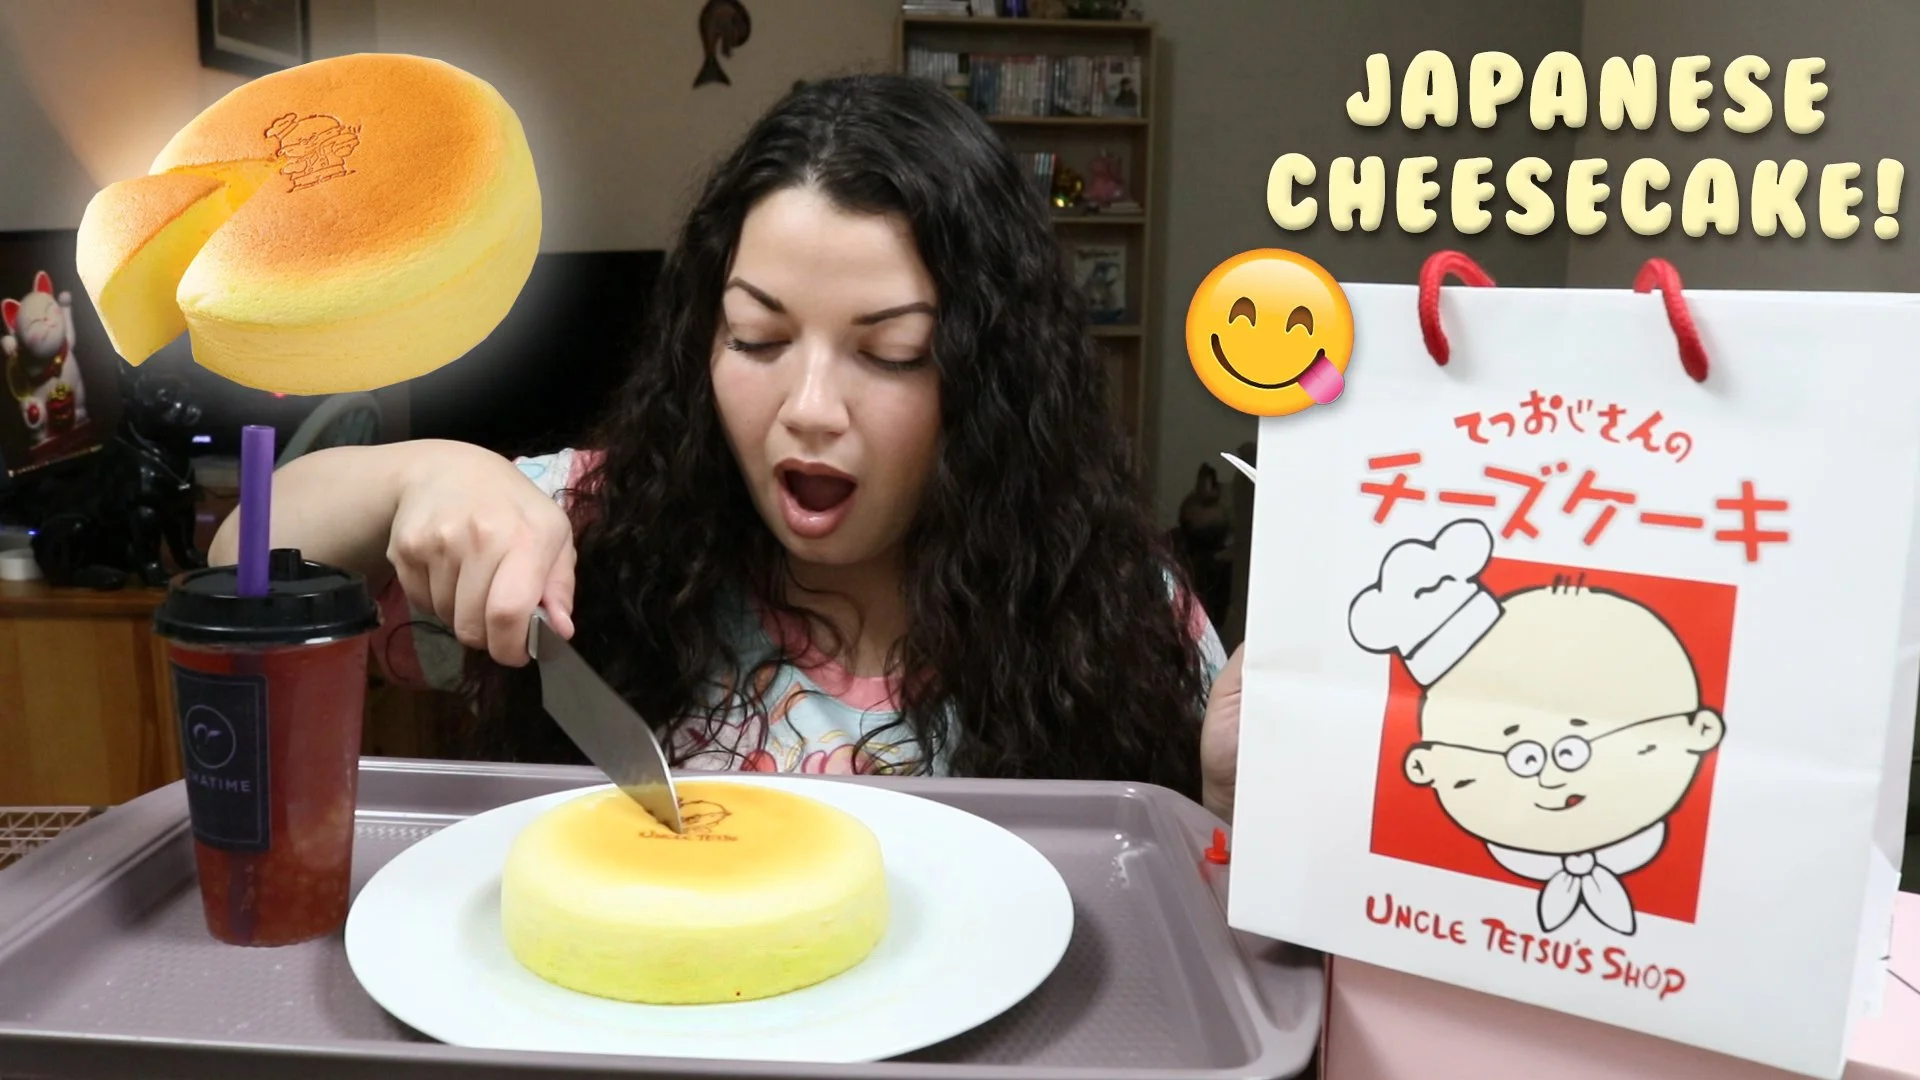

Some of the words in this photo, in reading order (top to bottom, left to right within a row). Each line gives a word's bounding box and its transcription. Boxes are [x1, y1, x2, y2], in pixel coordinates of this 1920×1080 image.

[1453, 389, 1694, 463] てつおじさんの
[1359, 451, 1791, 563] チーズケーキ
[1365, 894, 1467, 945] UNCLE
[1481, 917, 1594, 975] TETSU'S
[1602, 946, 1686, 1001] SHOP
